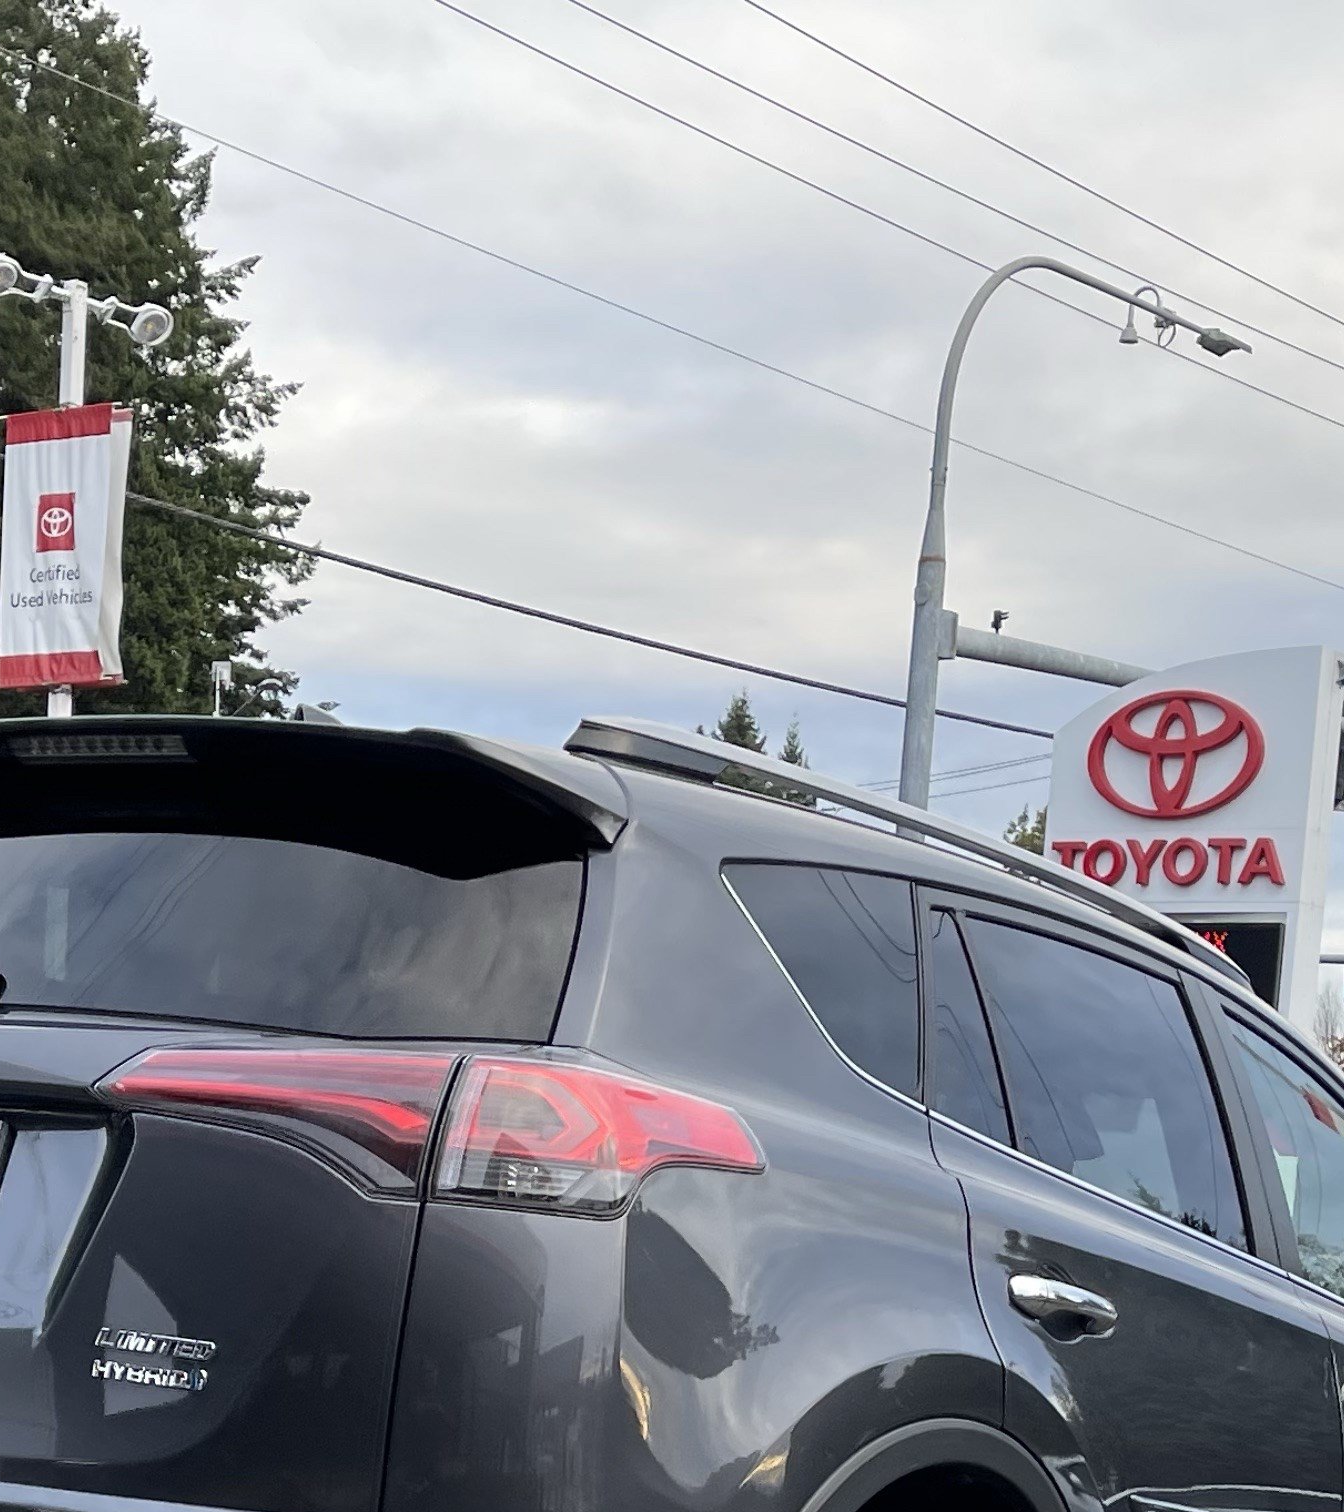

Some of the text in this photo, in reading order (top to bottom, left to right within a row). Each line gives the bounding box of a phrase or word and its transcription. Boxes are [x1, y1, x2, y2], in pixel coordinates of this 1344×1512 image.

[30, 564, 80, 583] Certified
[10, 588, 93, 608] Used Vehicles
[1052, 837, 1285, 887] TOYOTA
[91, 1359, 194, 1389] HYBRID
